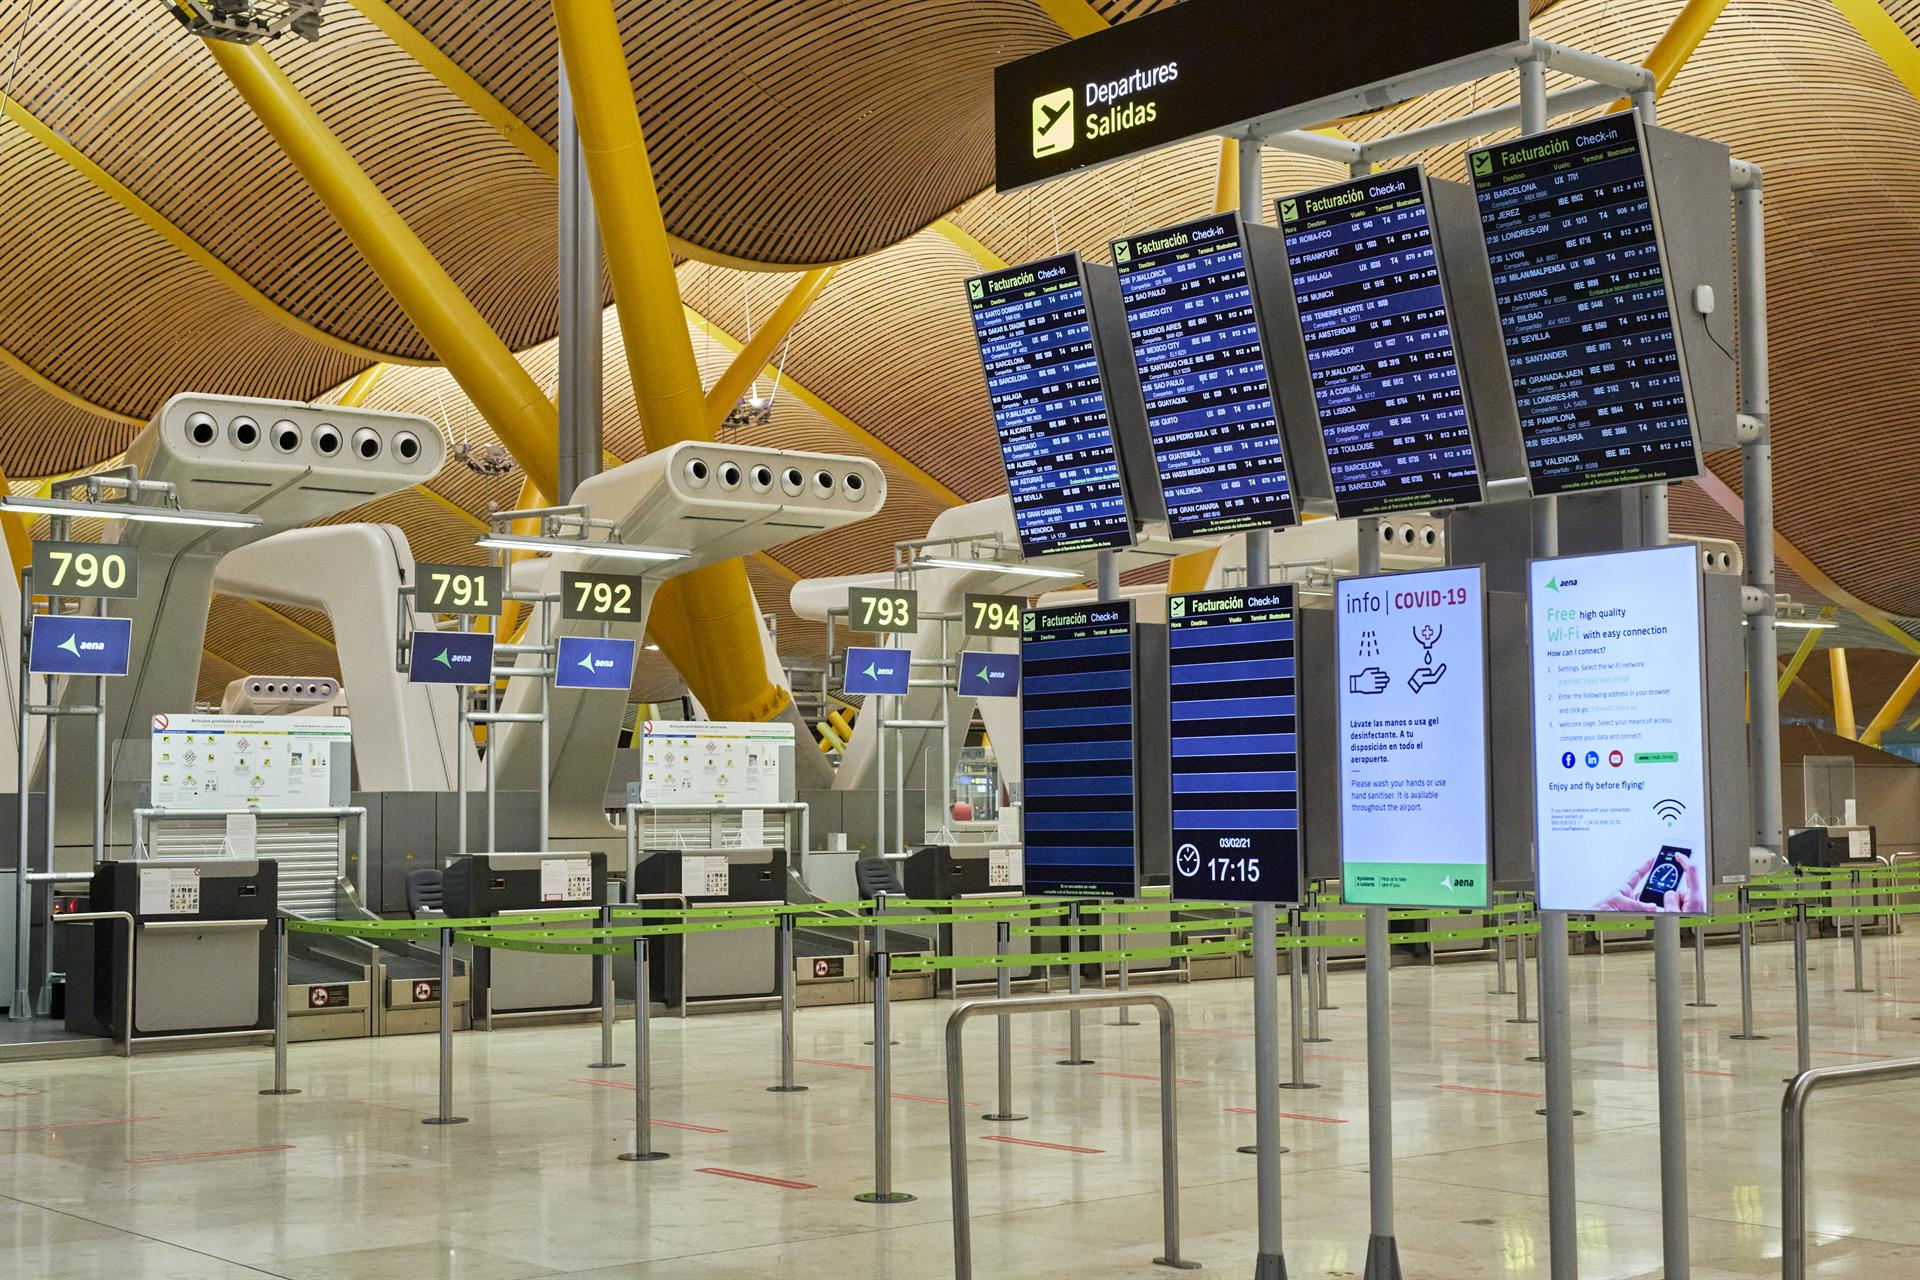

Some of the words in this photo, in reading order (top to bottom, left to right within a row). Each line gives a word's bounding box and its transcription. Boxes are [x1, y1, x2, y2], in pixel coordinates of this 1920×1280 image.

[1086, 61, 1178, 106] Departures
[1086, 100, 1156, 140] Salidas
[1500, 136, 1569, 166] Facturación
[1575, 127, 1618, 147] Check-in
[1502, 171, 1525, 182] Destino
[1552, 160, 1570, 170] Vuelo
[1582, 152, 1603, 163] Terminal
[1305, 187, 1364, 213] Facturación
[1368, 179, 1405, 197] Check-in
[1493, 182, 1536, 198] BARCELONA
[1496, 208, 1520, 220] JEREZ
[1594, 188, 1604, 197] T4
[1306, 218, 1326, 228] Destino
[1350, 209, 1365, 218] Vuelo
[1136, 230, 1188, 254] Facturación
[1191, 224, 1224, 241] Check-in
[1299, 230, 1332, 243] ROMA-FCO
[1501, 224, 1550, 241] LONDRES-GW
[1302, 248, 1339, 262] FRANKFURT
[1505, 250, 1524, 261] LYON
[988, 270, 1034, 292] Facturación
[1037, 264, 1065, 280] Check-in
[1306, 270, 1332, 282] MALAGA
[1135, 292, 1147, 300] SAO
[1147, 288, 1166, 298] PAULO
[1310, 290, 1334, 301] MUNICH
[1512, 288, 1547, 302] ASTURIAS
[1138, 308, 1160, 319] MEXICO
[1160, 305, 1173, 314] CITY
[1314, 308, 1342, 319] TENERIFE
[1343, 304, 1364, 314] NORTE
[1516, 311, 1543, 322] BILBAO
[1142, 325, 1165, 336] BUENOS
[1165, 322, 1182, 332] AIRES
[1317, 325, 1356, 338] AMSTERDAM
[1520, 331, 1550, 343] SEVILLA
[1146, 344, 1167, 354] MEXICO
[1167, 342, 1180, 350] CITY
[1321, 346, 1354, 358] PARIS-ORY
[1524, 350, 1567, 364] SANTANDER
[1149, 360, 1177, 371] SANTIAGO
[1177, 357, 1193, 366] CHILE
[1528, 368, 1583, 384] GRANADA-JAEN
[1334, 384, 1360, 394] CORUÑA
[1532, 390, 1578, 404] LONDRES-HR
[1333, 405, 1356, 415] LISBOA
[1161, 416, 1178, 425] QUITO
[1536, 412, 1576, 425] PAMPLONA
[1336, 422, 1370, 434] PARIS-ORY
[1540, 432, 1583, 445] BERLIN-BRA
[1340, 442, 1374, 453] TOULOUSE
[1344, 460, 1382, 471] BARCELONA
[1544, 454, 1579, 466] VALENCIA
[1348, 480, 1386, 490] BARCELONA
[49, 552, 126, 589] 790
[1560, 579, 1577, 587] aena
[432, 574, 488, 606] 791
[574, 582, 631, 614] 792
[1192, 597, 1243, 612] Facturación
[1248, 595, 1279, 607] Check-in
[1347, 592, 1380, 613] info
[1395, 588, 1466, 609] COVID-19
[861, 597, 909, 626] 793
[972, 603, 1019, 630] 794
[1547, 609, 1576, 621] Free
[1580, 611, 1596, 619] high
[1599, 608, 1626, 619] quality
[1042, 612, 1086, 627] Facturación
[1091, 612, 1118, 622] Check-in
[1191, 619, 1207, 627] Destino
[1548, 626, 1579, 642] Wi-Fi
[1583, 631, 1600, 639] with
[1603, 631, 1621, 639] easy
[1623, 626, 1667, 637] connection
[80, 641, 104, 651] aena
[1578, 647, 1606, 655] connect?
[451, 654, 471, 662] aena
[989, 671, 1004, 679] aena
[1350, 719, 1371, 728] Lávate
[1428, 717, 1439, 726] gel
[1351, 731, 1398, 740] desinfectante.
[1351, 743, 1387, 752] disposición
[1400, 742, 1414, 750] todo
[1351, 756, 1389, 764] aeropuerto.
[1373, 779, 1388, 787] wash
[1390, 780, 1404, 788] your
[1549, 783, 1568, 792] Enjoy
[1570, 782, 1583, 790] and
[1585, 782, 1594, 791] fly
[1596, 781, 1620, 790] before
[1622, 781, 1645, 790] flying!
[1411, 791, 1438, 799] available
[1352, 804, 1386, 813] throughout
[1220, 837, 1250, 848] 03/02/21
[1208, 858, 1259, 882] 17:15
[1454, 878, 1473, 887] aena
